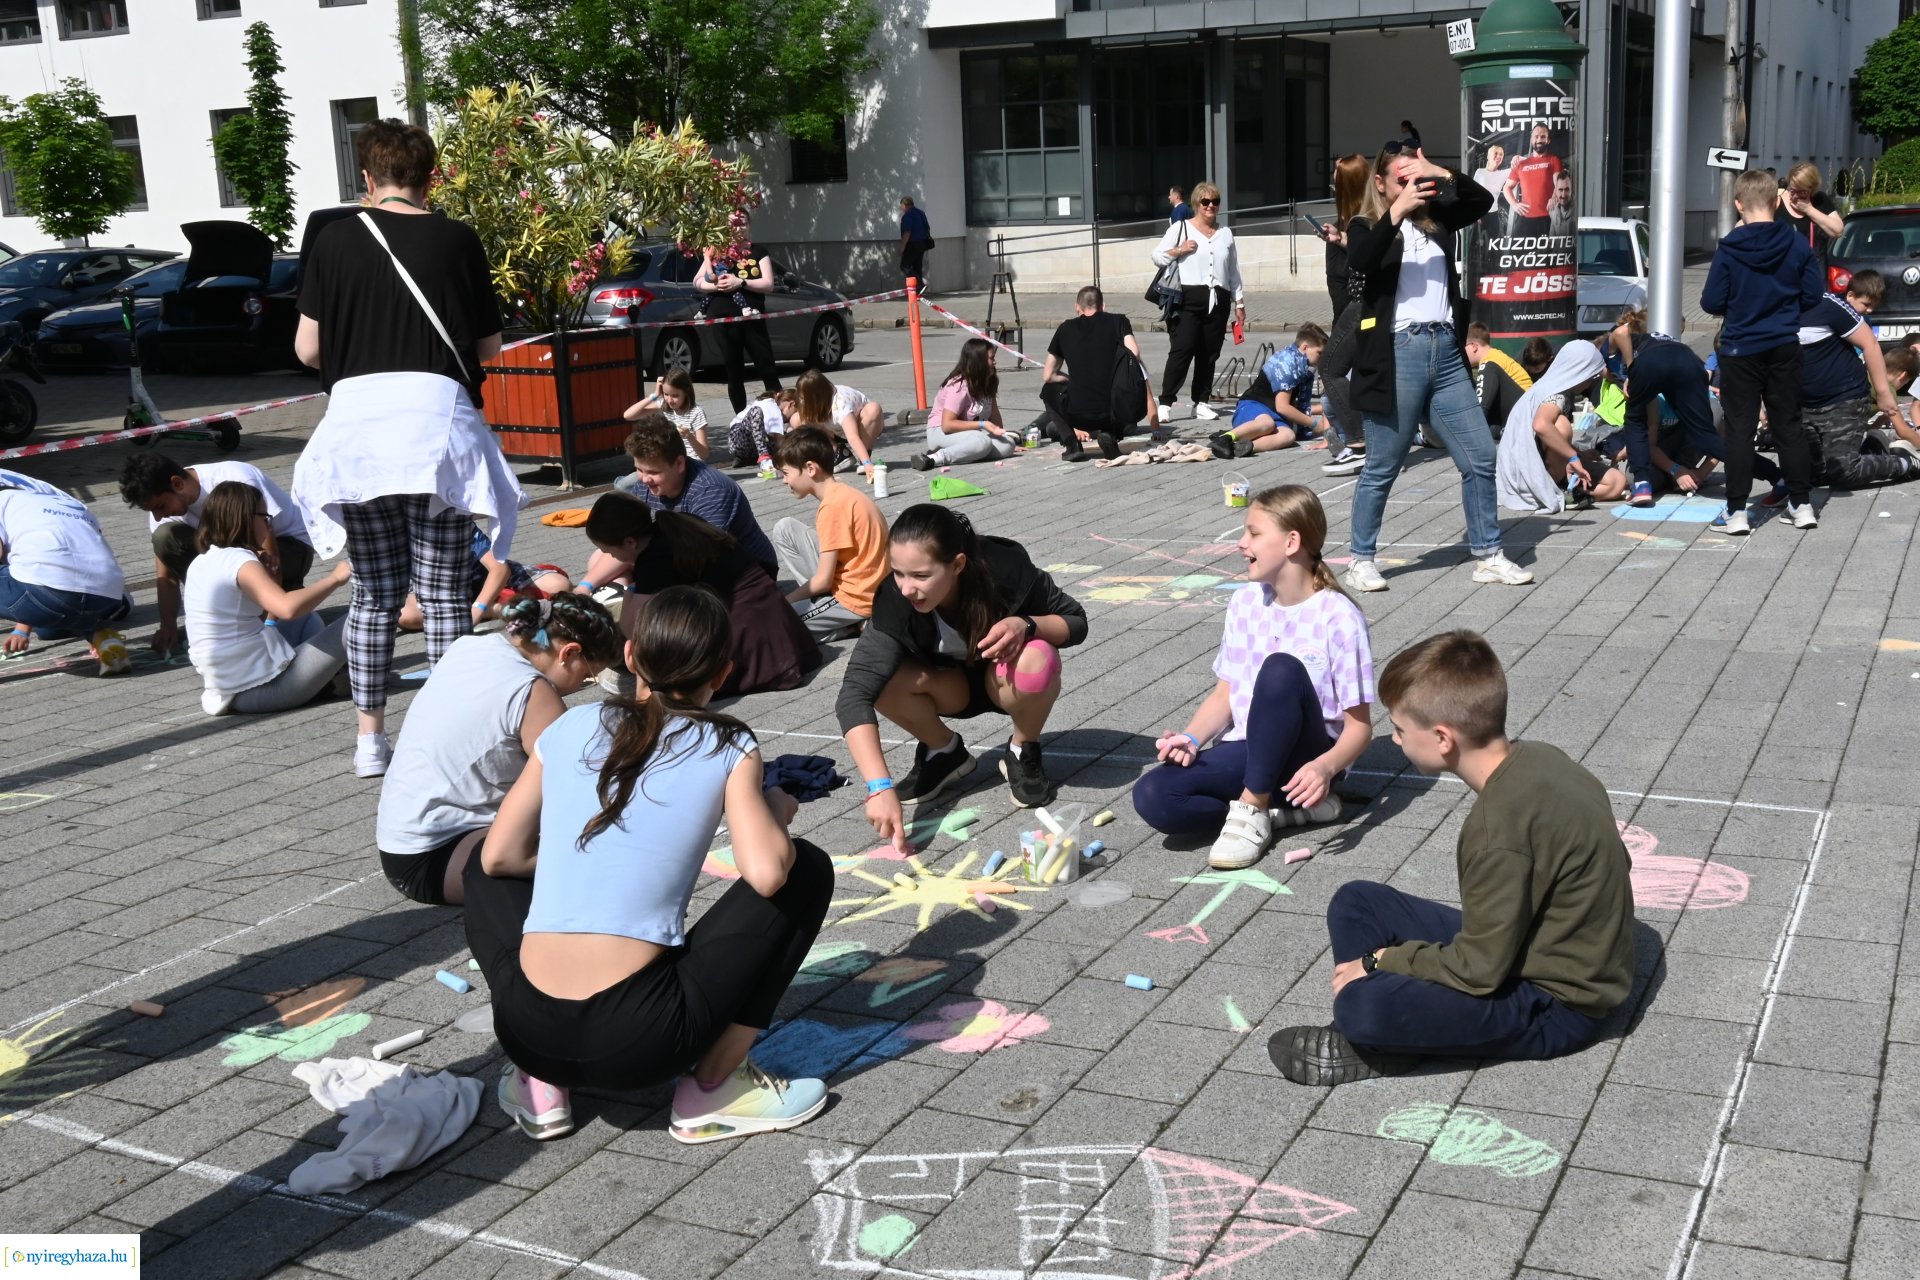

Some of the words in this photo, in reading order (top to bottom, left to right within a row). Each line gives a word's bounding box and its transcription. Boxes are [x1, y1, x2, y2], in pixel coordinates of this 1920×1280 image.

[1448, 22, 1467, 38] E.NY
[1450, 38, 1471, 52] 07-002
[1481, 97, 1575, 118] SCITE
[1481, 116, 1576, 134] NUTRITIO
[1500, 252, 1574, 268] GYŐZTEK.
[1480, 277, 1508, 295] TE
